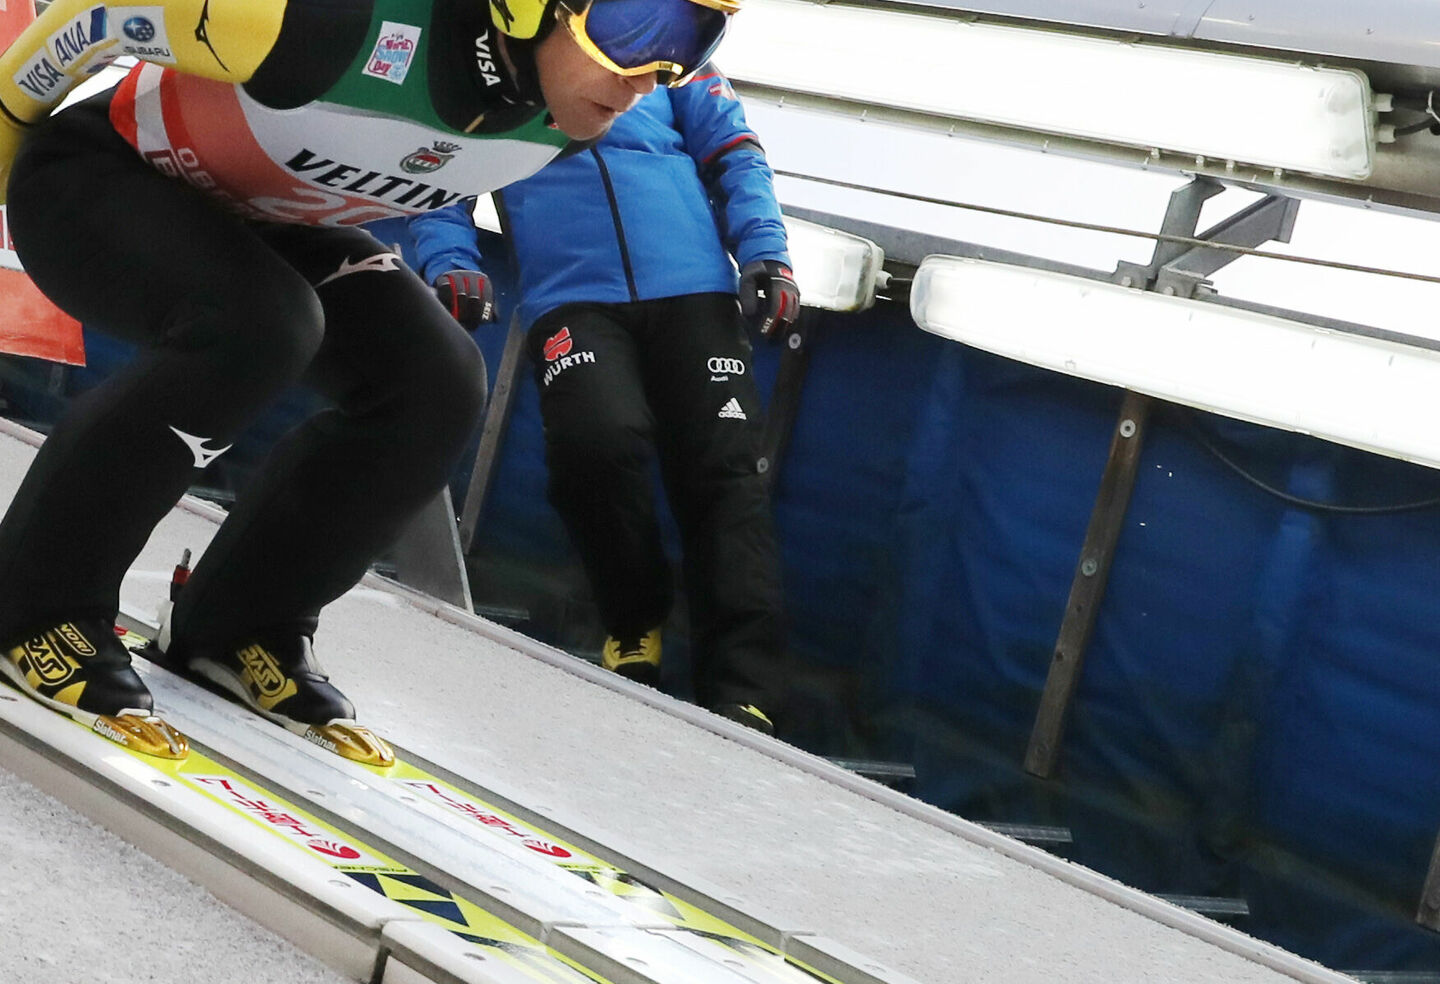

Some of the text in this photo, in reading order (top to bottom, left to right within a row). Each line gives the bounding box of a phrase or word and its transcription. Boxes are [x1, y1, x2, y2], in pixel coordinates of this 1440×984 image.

[55, 21, 91, 67] ANA
[474, 28, 501, 88] VISA
[18, 55, 65, 99] VISA
[285, 148, 468, 210] VELTIN
[543, 351, 596, 387] WÜRTH
[93, 719, 126, 744] Slatnar
